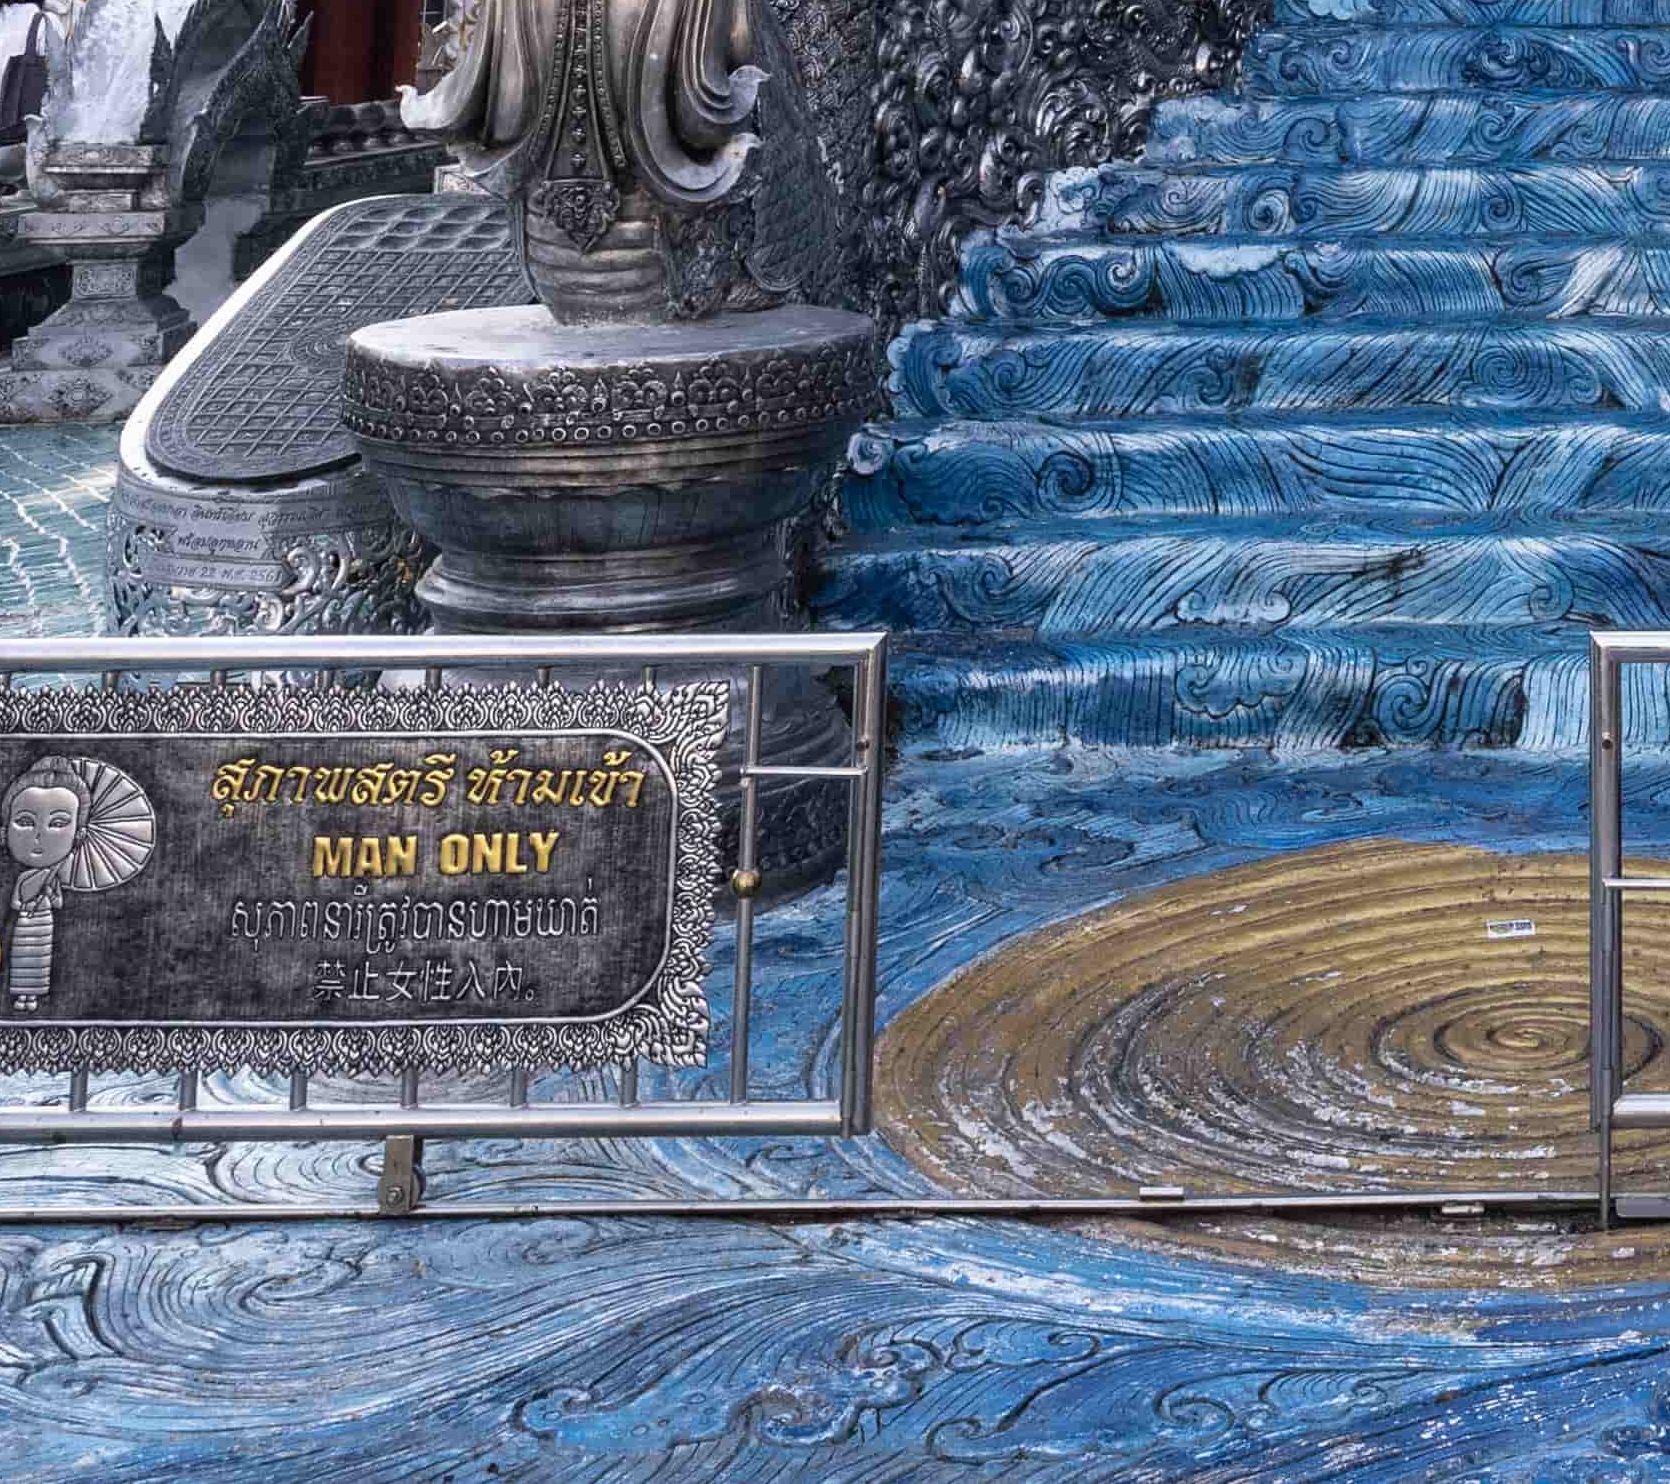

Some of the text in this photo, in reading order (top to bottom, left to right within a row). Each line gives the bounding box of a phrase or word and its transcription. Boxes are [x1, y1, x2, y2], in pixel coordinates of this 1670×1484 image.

[211, 749, 648, 817] สุภาพสตรี ห้ามเข้า
[313, 832, 561, 878] MAN ONLY
